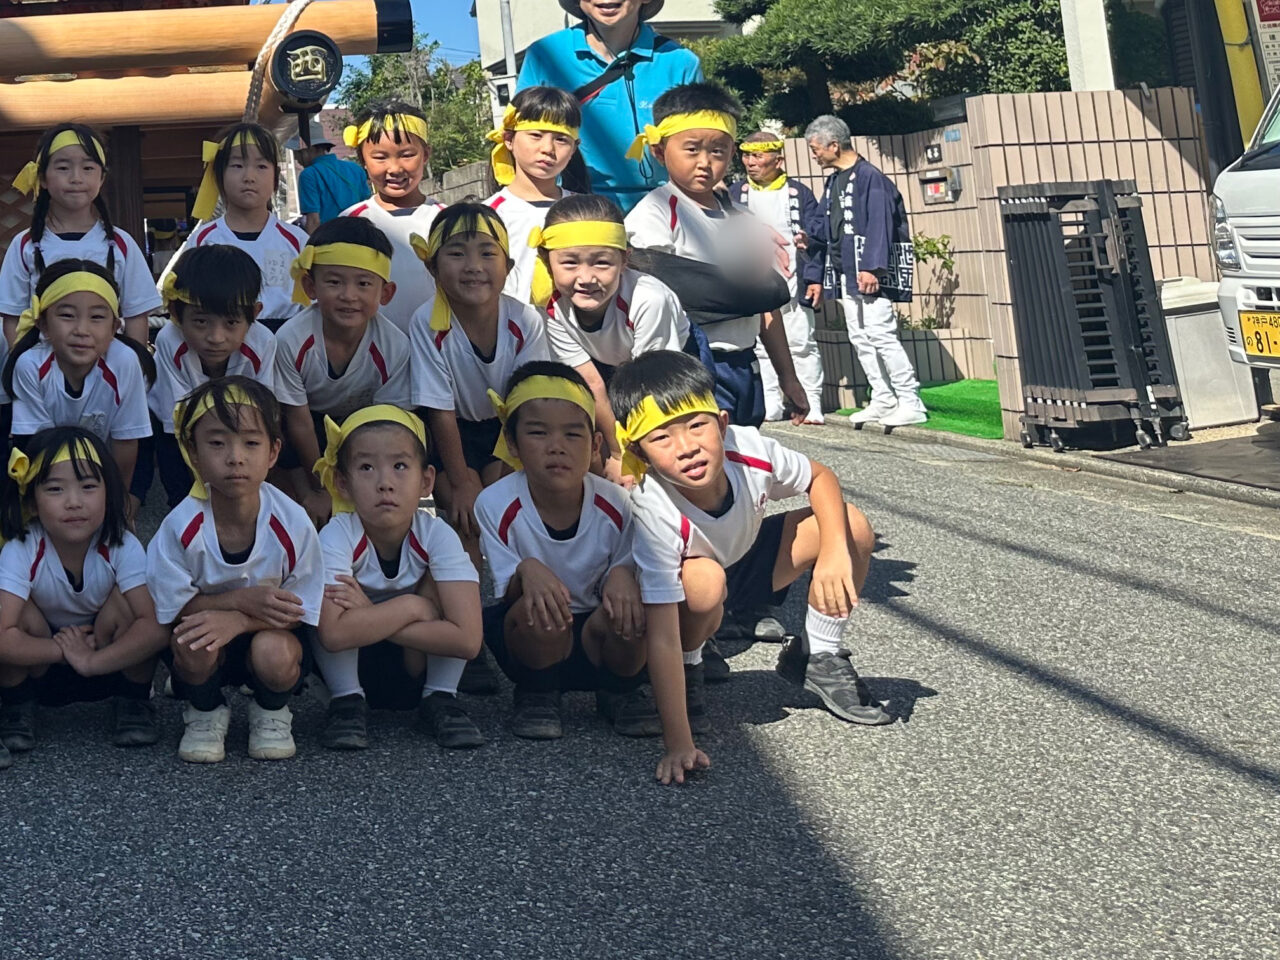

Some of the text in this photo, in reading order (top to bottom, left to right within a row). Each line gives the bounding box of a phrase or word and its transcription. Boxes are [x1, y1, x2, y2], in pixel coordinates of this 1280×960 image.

[286, 45, 328, 82] 西
[1251, 315, 1268, 327] 神戸
[1246, 336, 1254, 346] の
